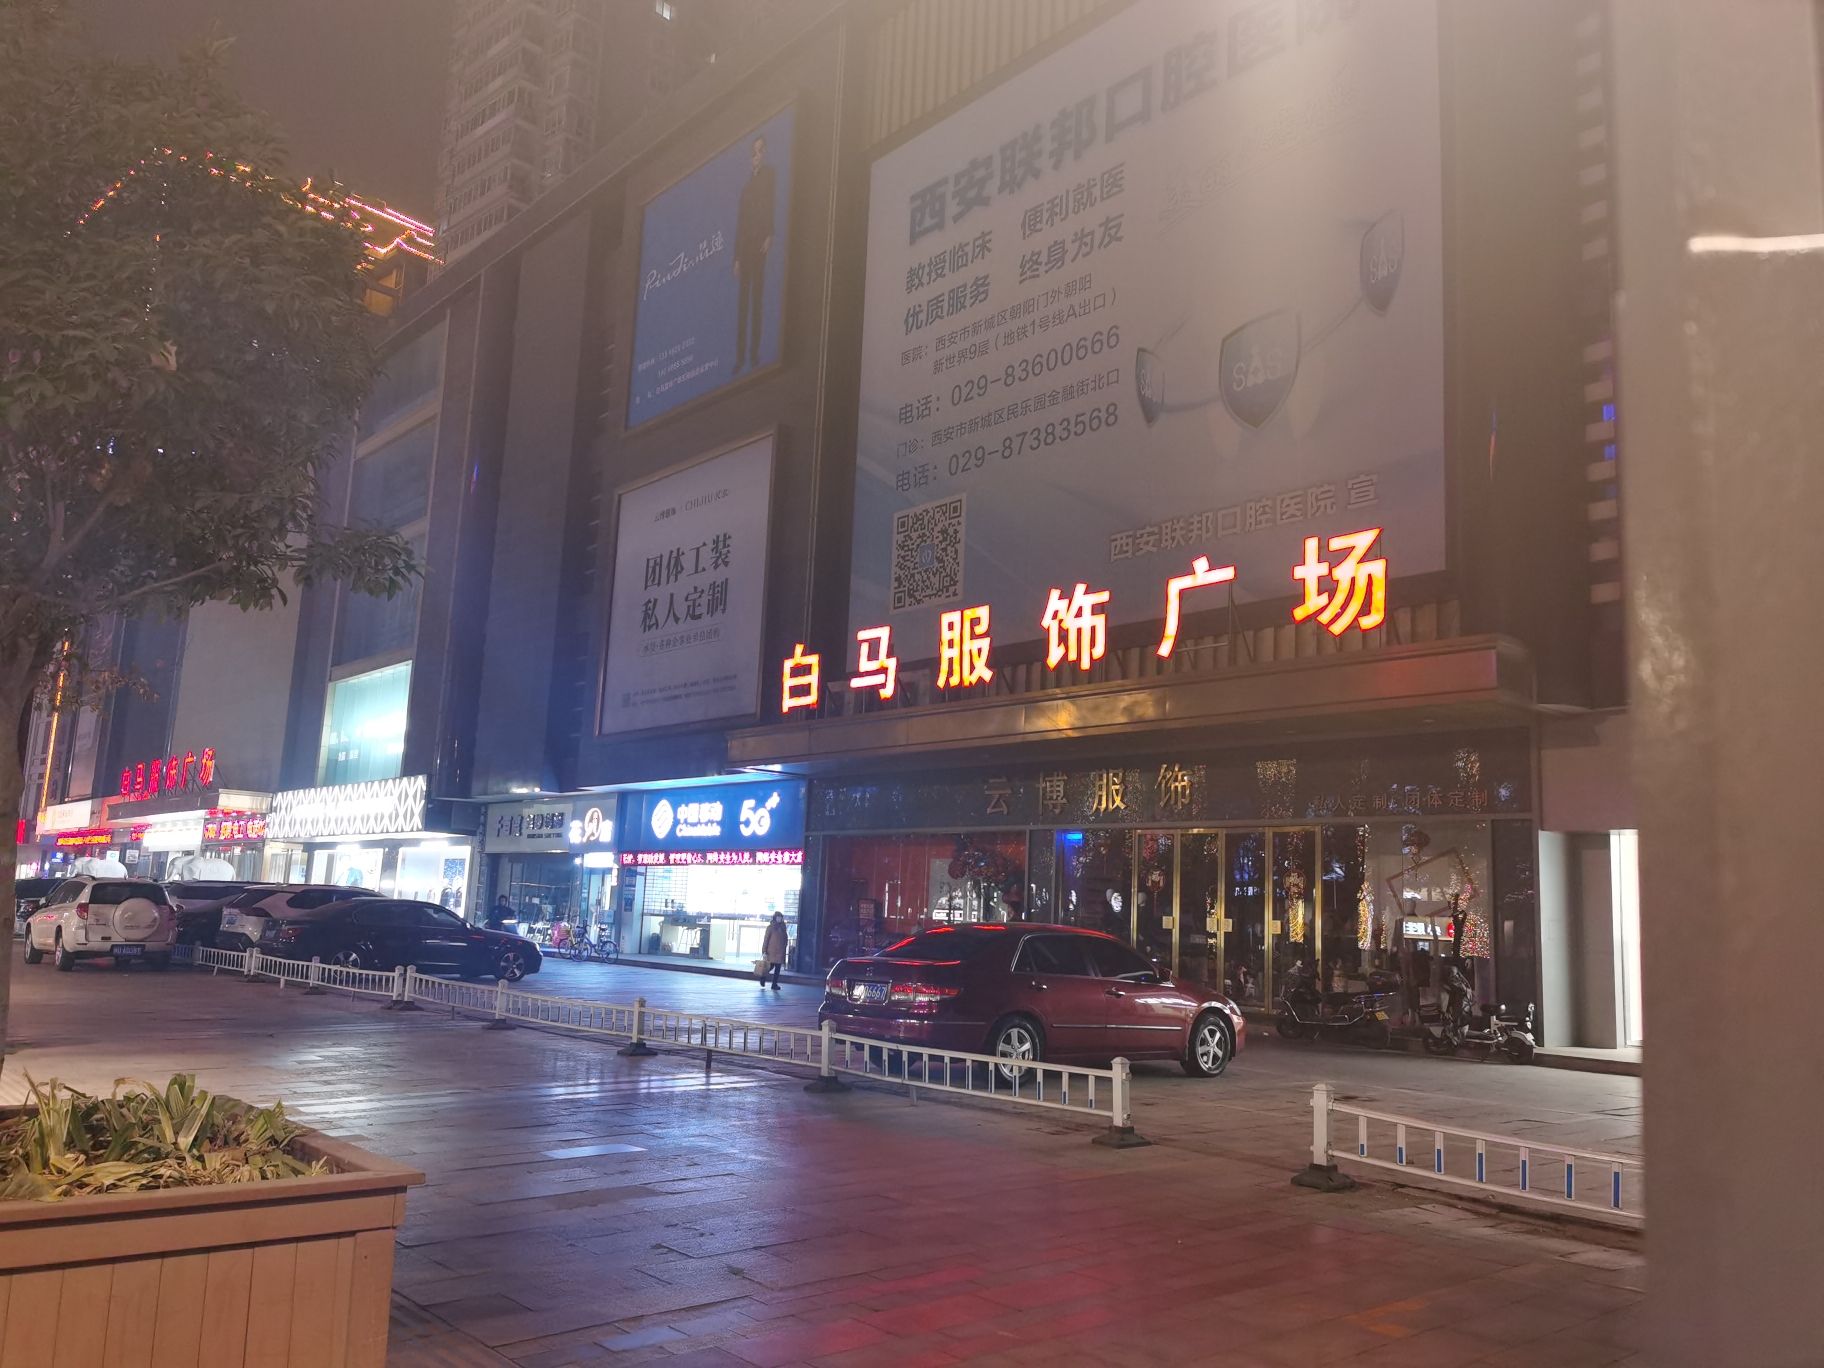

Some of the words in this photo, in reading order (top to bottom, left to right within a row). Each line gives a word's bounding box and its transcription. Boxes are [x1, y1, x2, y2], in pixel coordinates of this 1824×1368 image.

[905, 229, 993, 295] 教授临床
[1020, 161, 1127, 241] 便利就医
[903, 275, 992, 335] 优质服务
[1018, 213, 1126, 286] 终身为友
[1109, 482, 1337, 563] 西安联邦口腔医院
[1346, 473, 1380, 510] 宣
[643, 532, 733, 592] 团体工装
[639, 577, 729, 634] 私人定制
[780, 527, 1389, 714] 白马服饰广场
[984, 762, 1193, 816] 云博服饰
[1403, 789, 1488, 808] 团体定制
